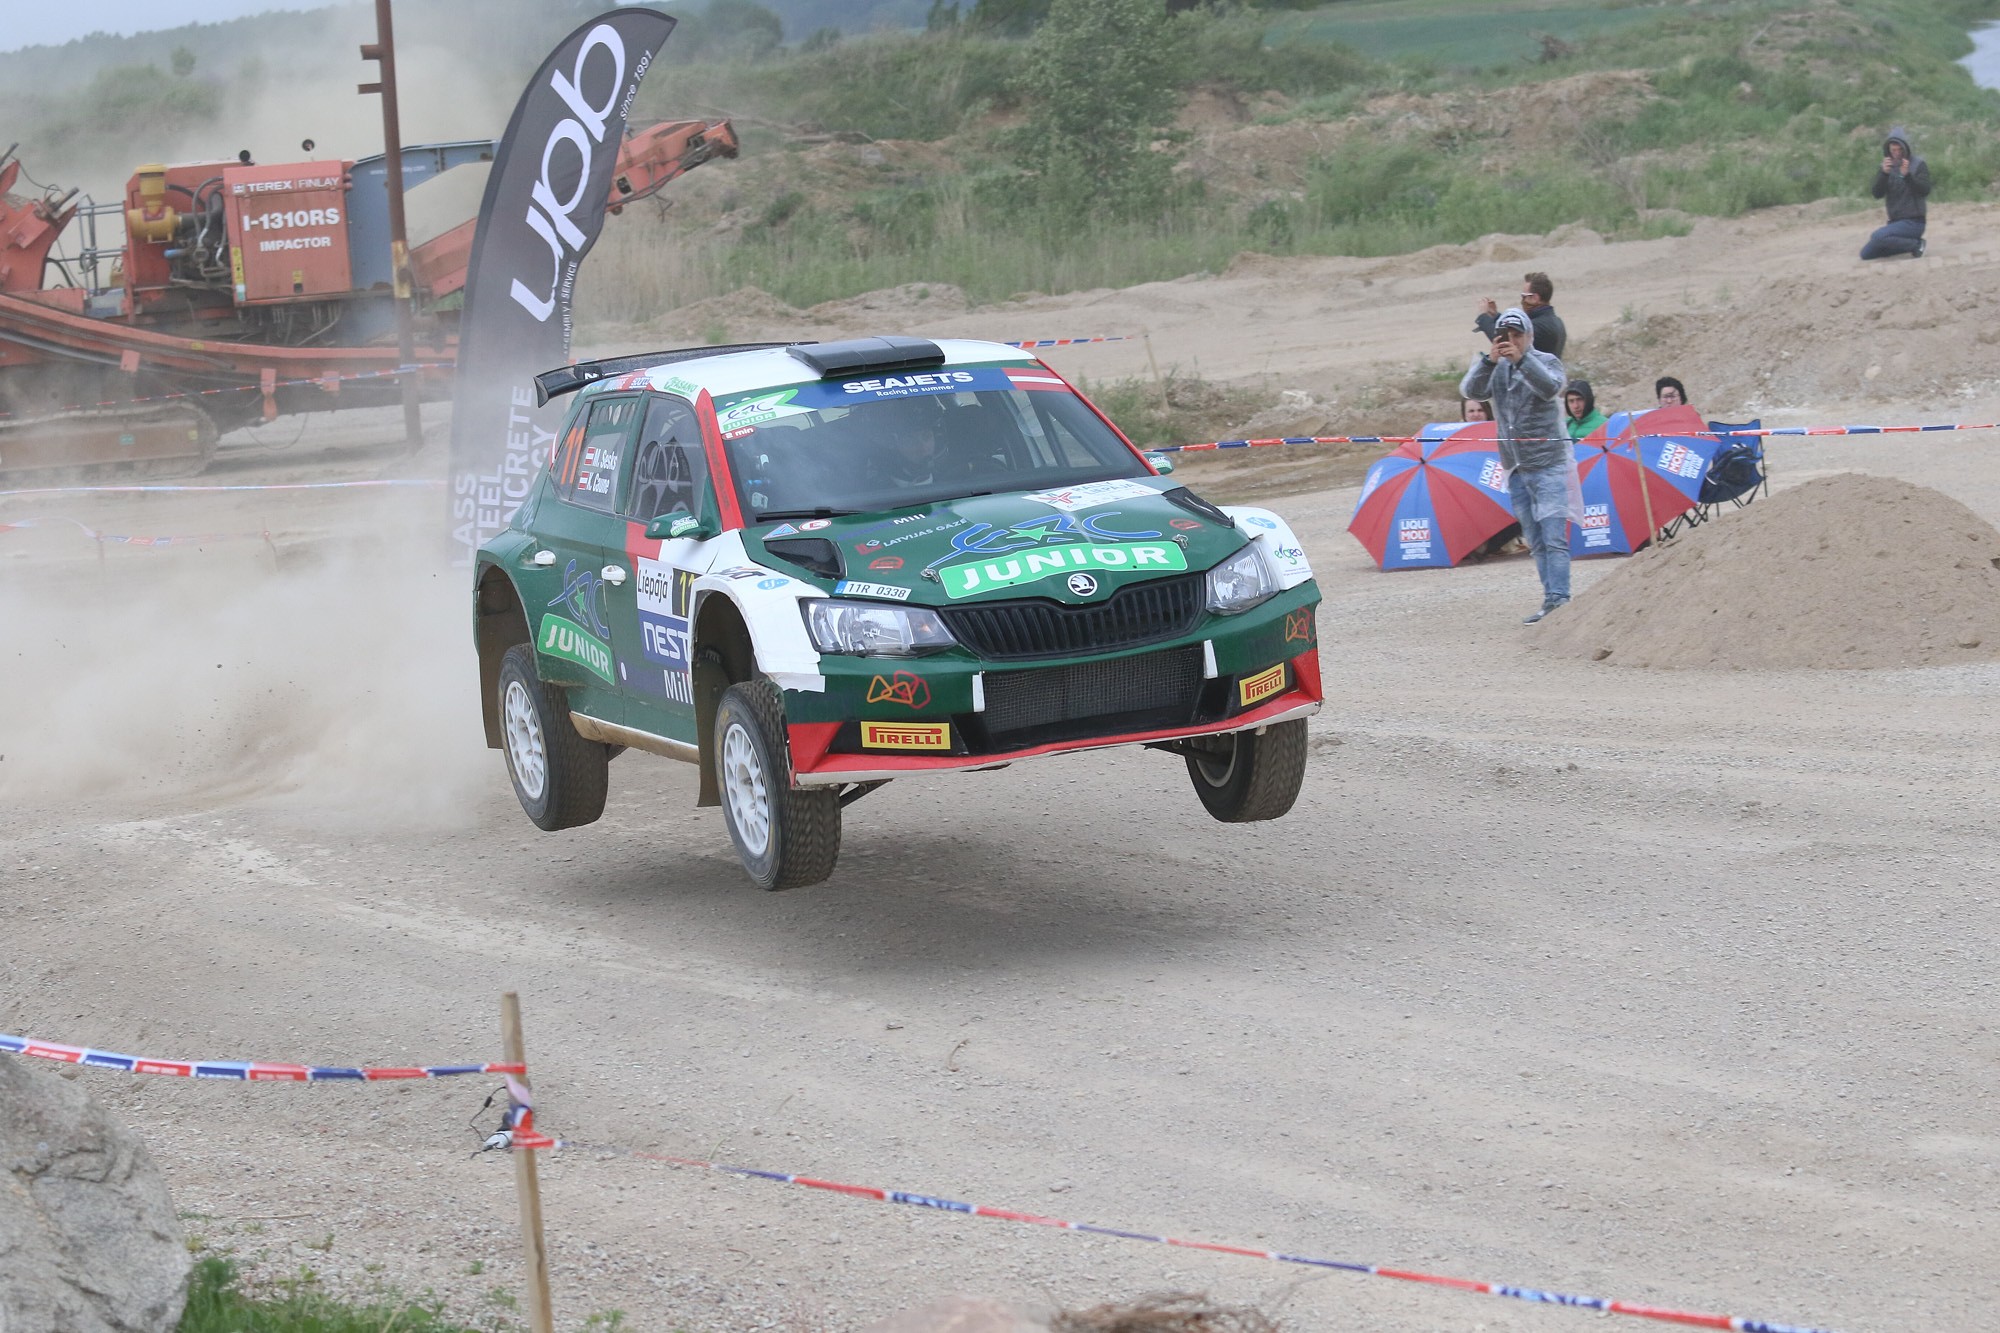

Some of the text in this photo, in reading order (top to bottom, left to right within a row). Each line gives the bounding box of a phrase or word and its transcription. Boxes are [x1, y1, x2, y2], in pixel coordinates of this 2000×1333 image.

[619, 49, 653, 121] since 1991
[247, 177, 339, 192] TEREX FINLAY
[243, 208, 339, 231] I-1310RS
[260, 237, 331, 252] IMPACTOR
[842, 372, 974, 394] SEAJETS
[876, 388, 908, 397] Racing
[727, 413, 773, 430] JUNIOR
[735, 427, 754, 436] min
[561, 427, 585, 485] 11
[1658, 442, 1675, 469] LIQUI
[1669, 445, 1687, 473] MOLY
[1479, 458, 1496, 485] LIQUI
[1400, 519, 1428, 529] LIQUI
[883, 528, 933, 547] LATVIJAS
[1400, 530, 1430, 541] MOLY
[963, 547, 1170, 590] JUNIOR
[849, 583, 870, 593] 11R
[876, 587, 907, 598] 0338
[546, 624, 610, 676] JUNIOR
[1245, 669, 1281, 700] PIRELLI
[869, 726, 942, 744] PIRELLI
